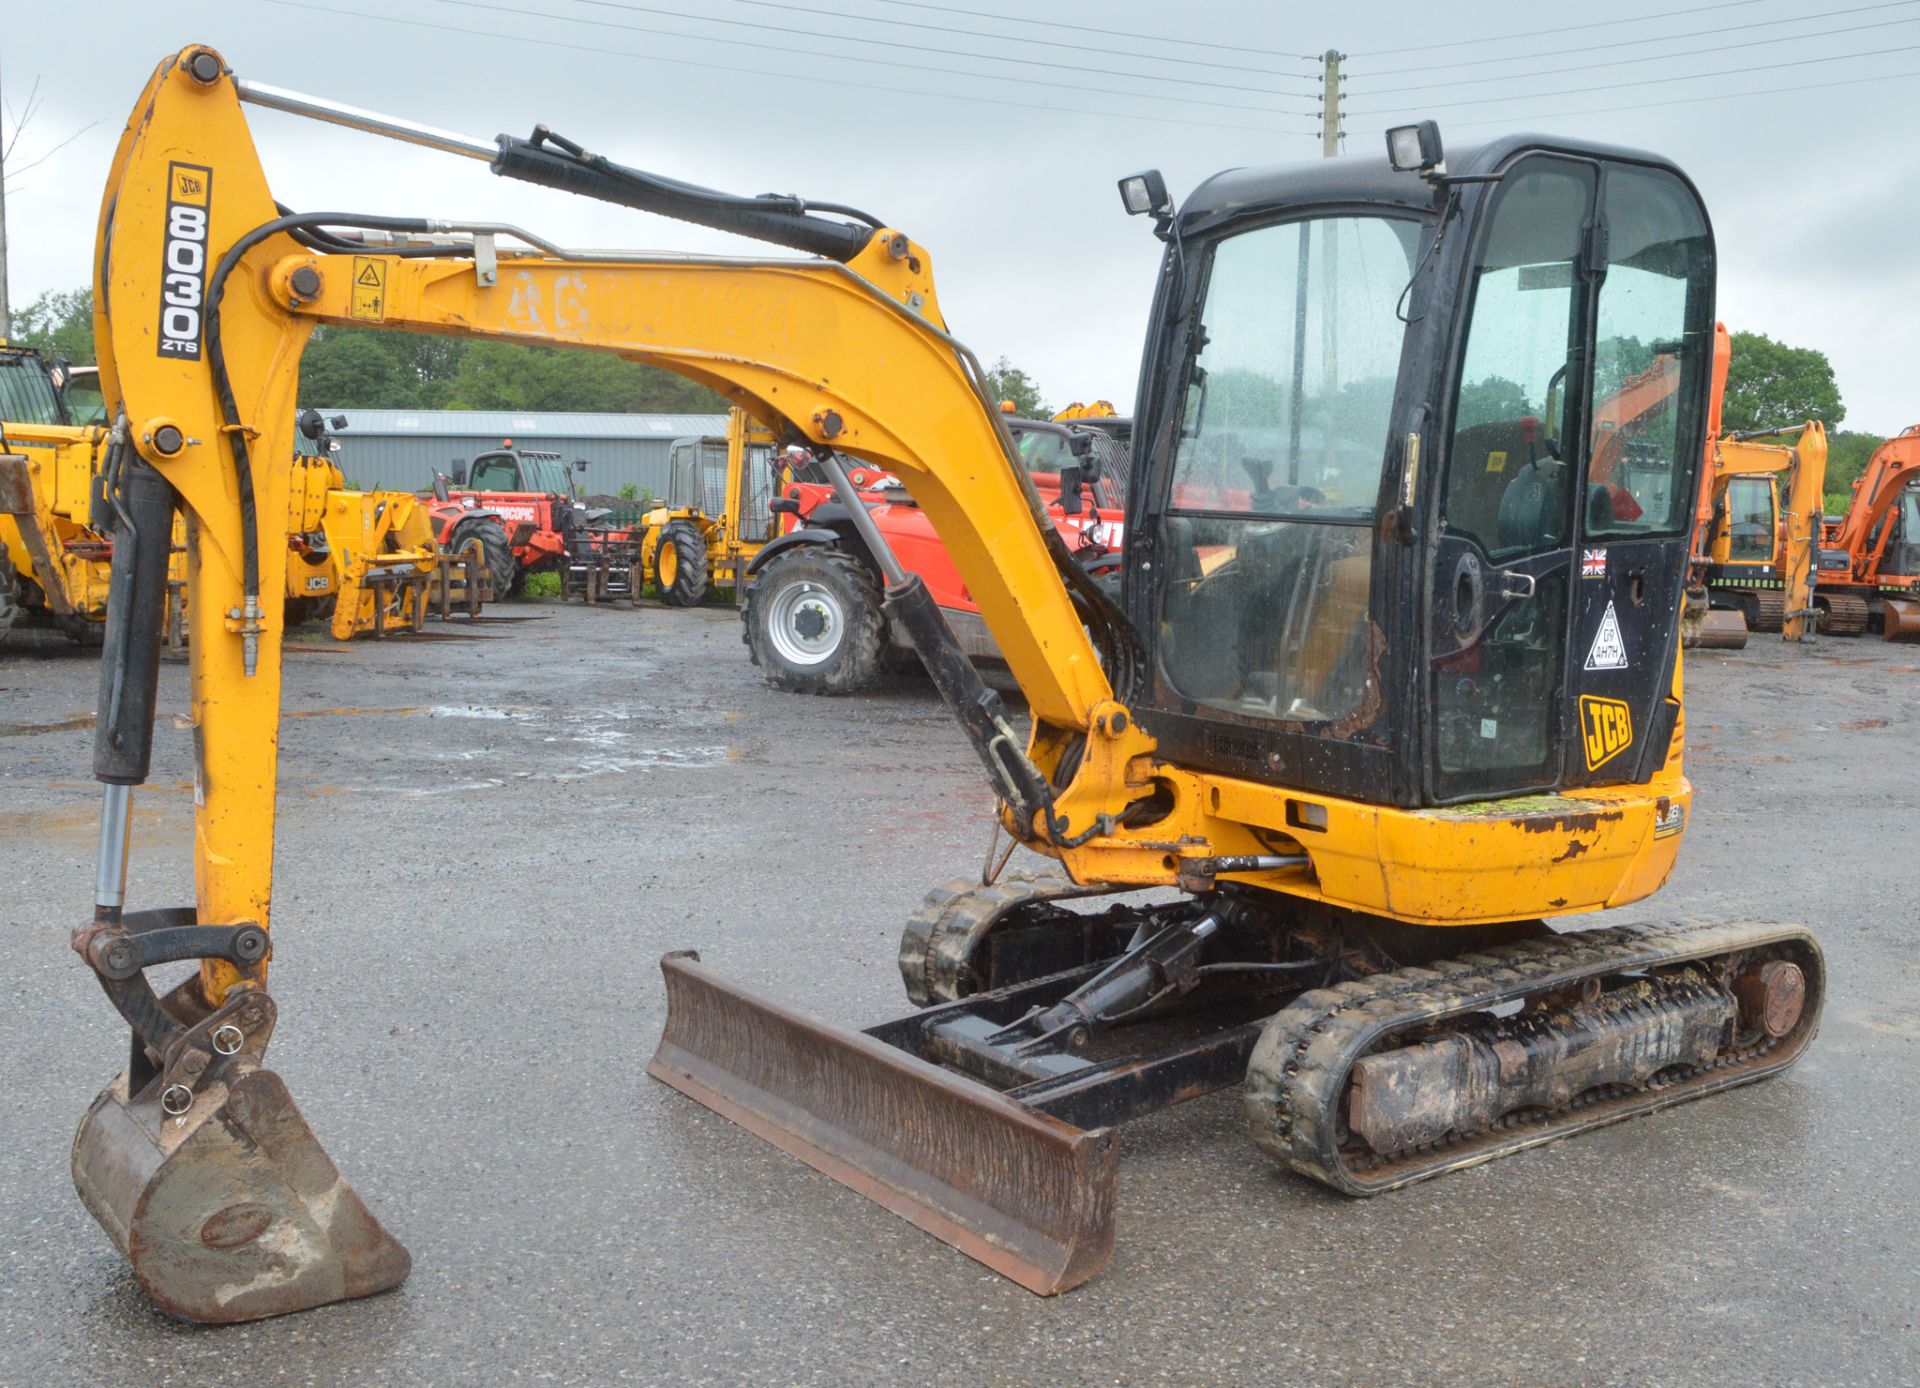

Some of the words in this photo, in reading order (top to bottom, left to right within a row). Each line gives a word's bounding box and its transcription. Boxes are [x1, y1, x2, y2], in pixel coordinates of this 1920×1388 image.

[181, 175, 202, 194] JCB
[163, 205, 206, 341] 8030
[162, 339, 198, 353] ZTS
[305, 576, 329, 590] JCB
[1588, 703, 1629, 762] JCB
